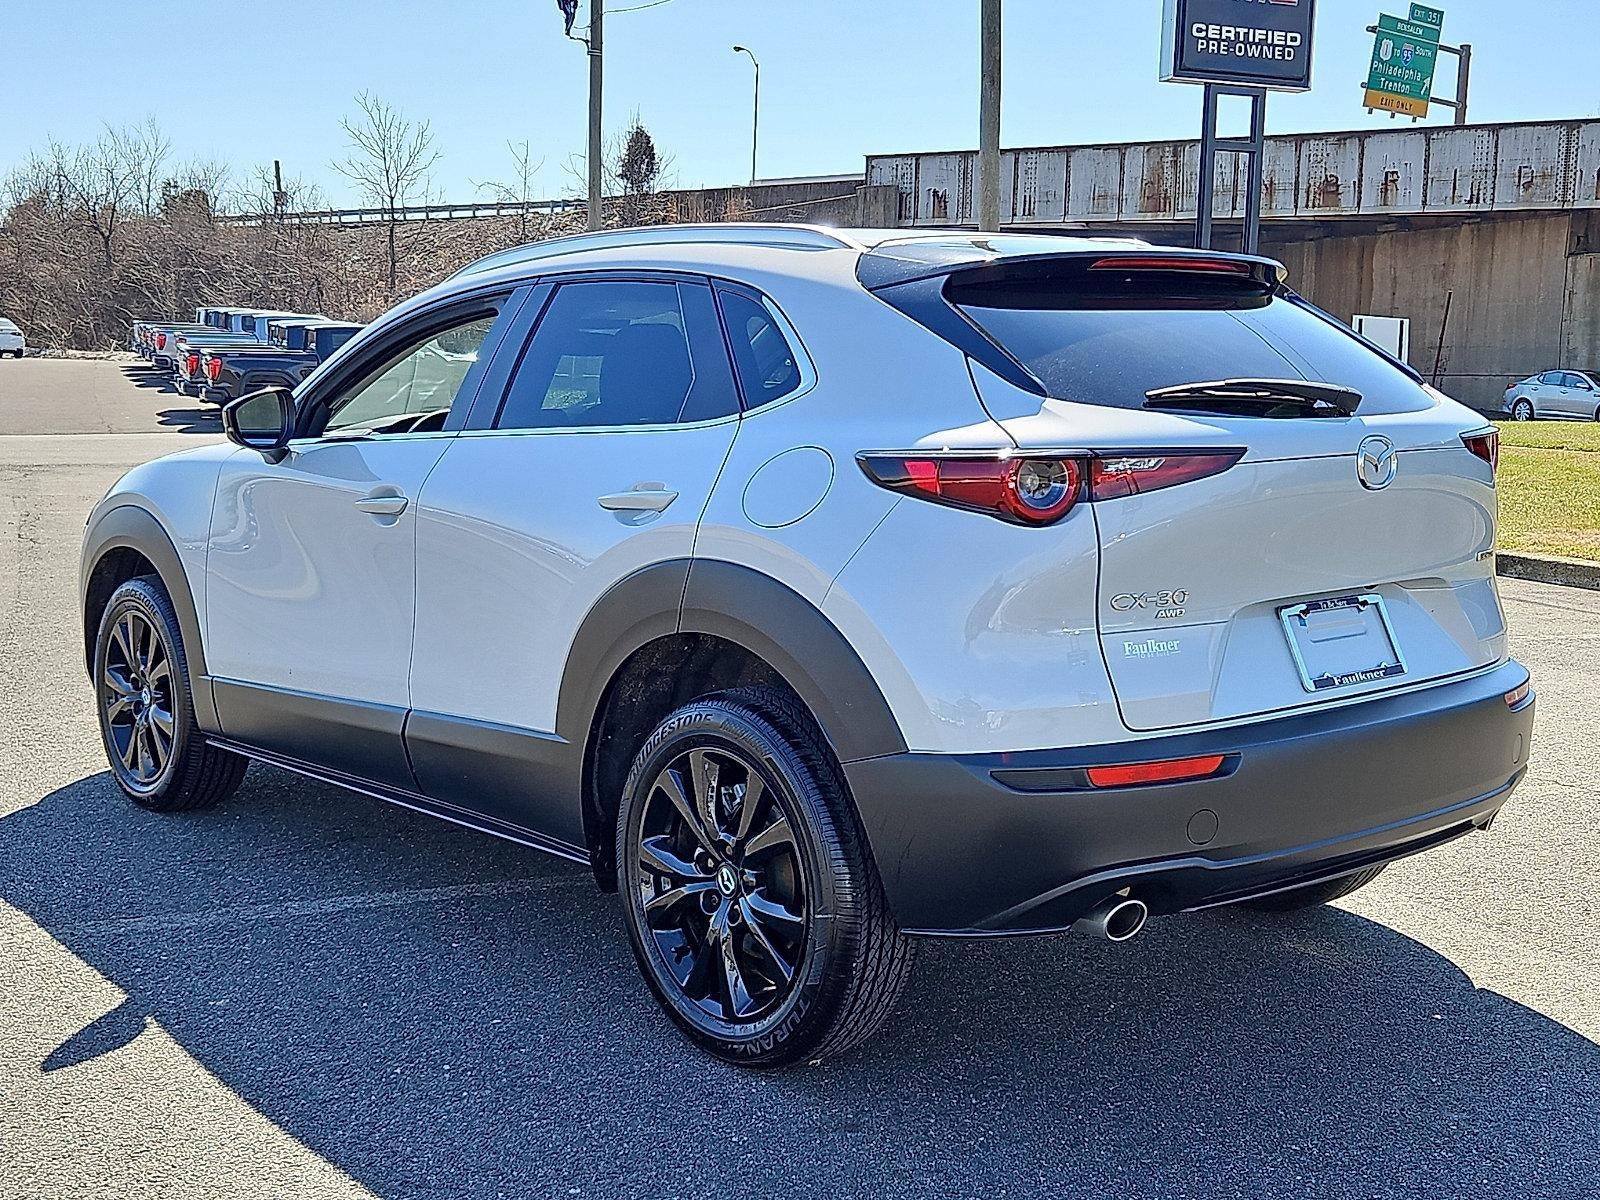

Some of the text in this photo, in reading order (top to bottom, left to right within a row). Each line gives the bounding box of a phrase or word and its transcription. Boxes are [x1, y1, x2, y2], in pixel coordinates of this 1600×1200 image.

[1428, 12, 1440, 24] 351
[1191, 23, 1301, 46] CERTIFIED
[1396, 22, 1424, 35] BENSALEM
[1197, 39, 1295, 61] PRE-OWNED
[1403, 51, 1412, 61] 95
[1372, 61, 1421, 81] Philadelphia
[1380, 78, 1410, 94] Trenton
[1380, 97, 1412, 111] EXIT ONLY
[1110, 588, 1189, 611] CX-30
[1155, 608, 1186, 619] AWD
[1123, 639, 1180, 655] Faulkner
[1334, 671, 1386, 685] Faulkner
[728, 998, 811, 1056] TURANZ
